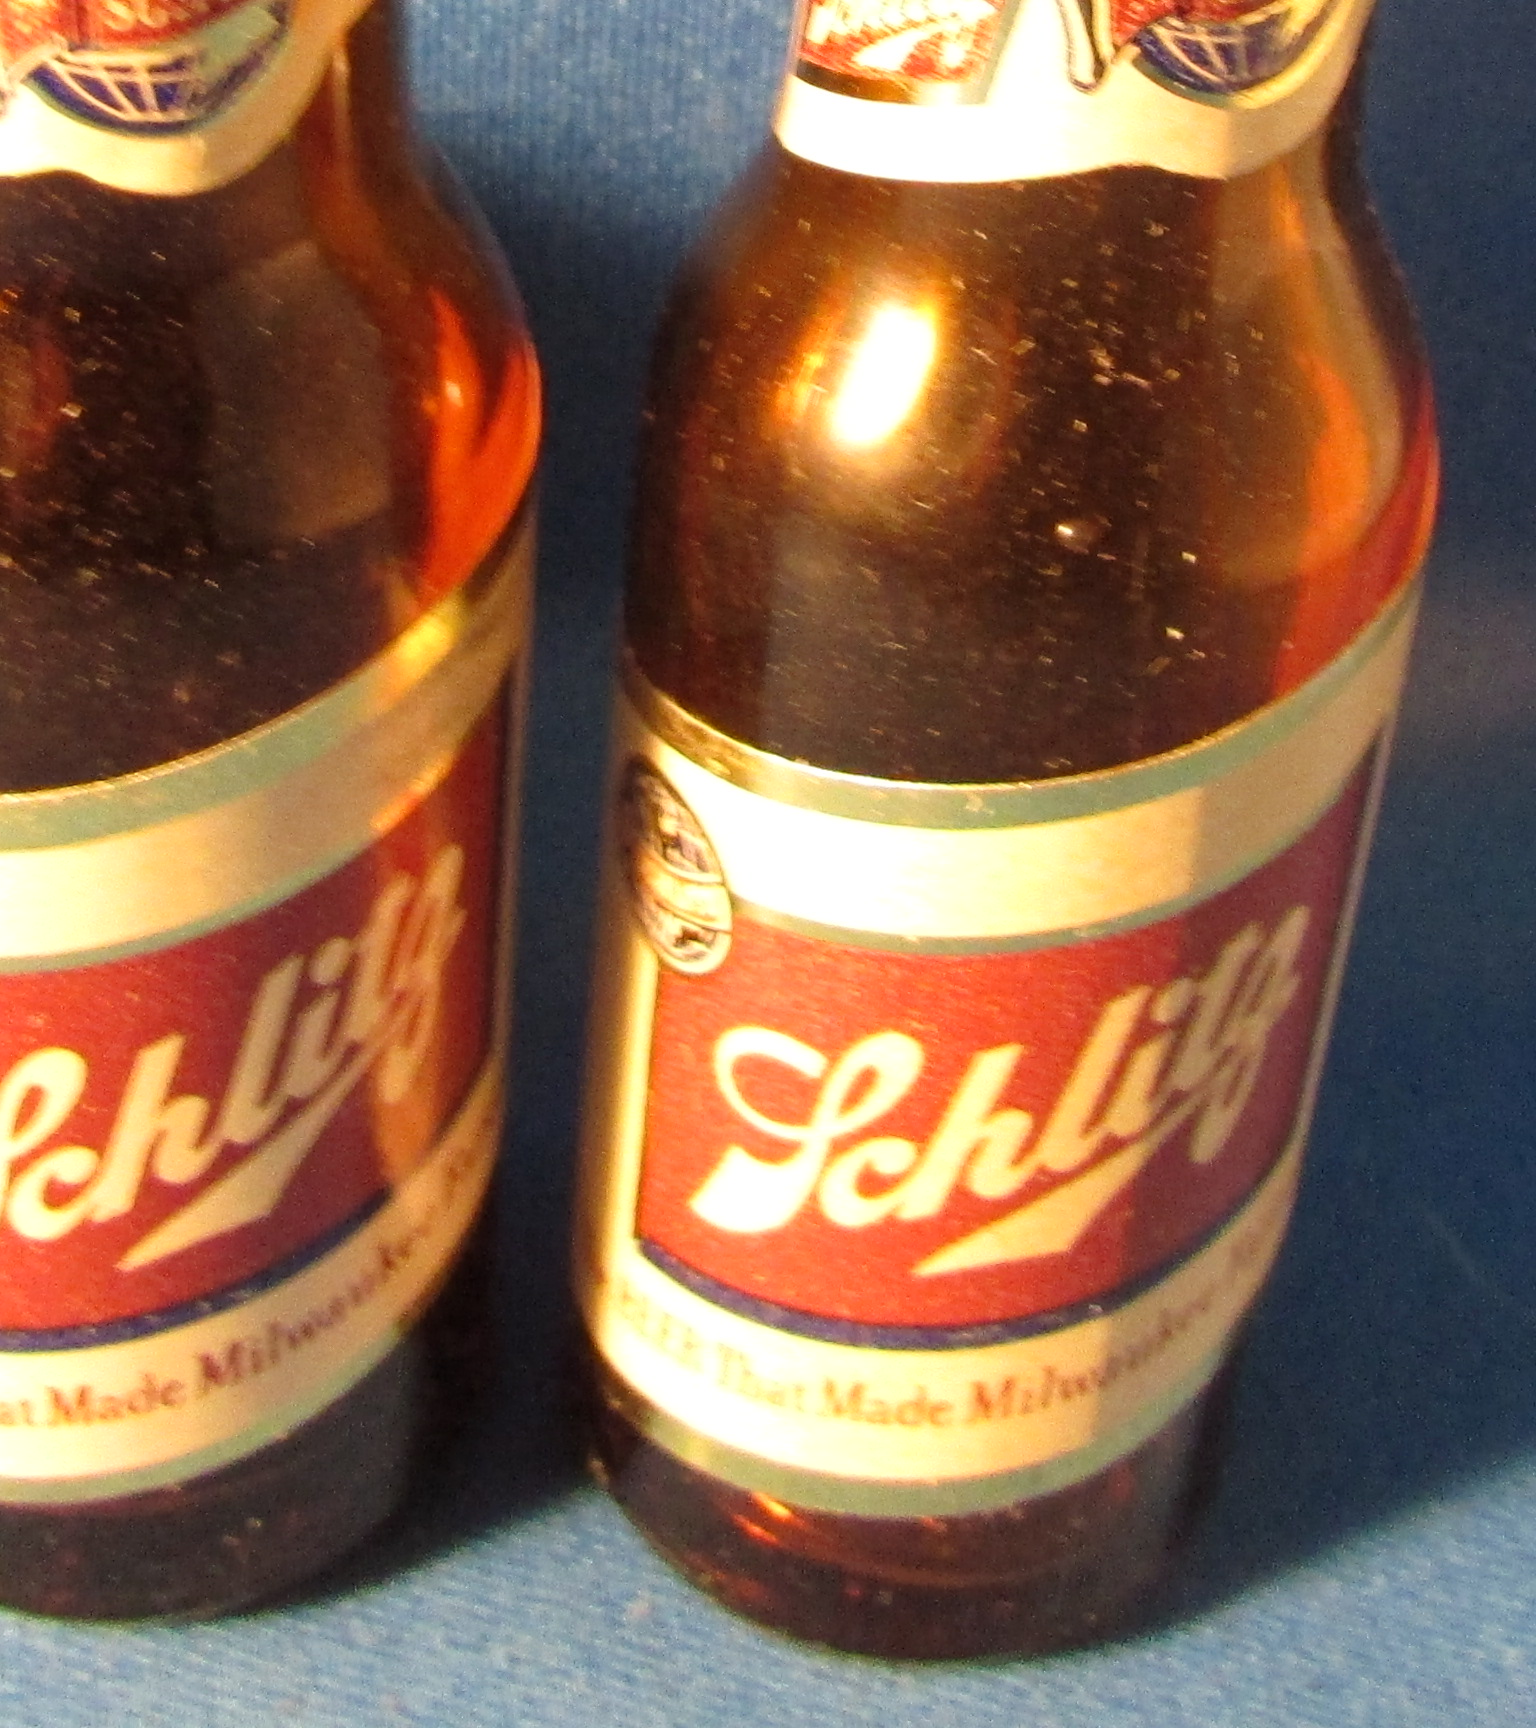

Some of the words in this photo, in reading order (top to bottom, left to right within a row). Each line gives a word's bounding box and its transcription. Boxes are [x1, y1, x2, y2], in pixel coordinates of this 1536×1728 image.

[688, 906, 1310, 1277] Schlitz
[46, 1370, 186, 1427] Made
[821, 1375, 956, 1428] Made
